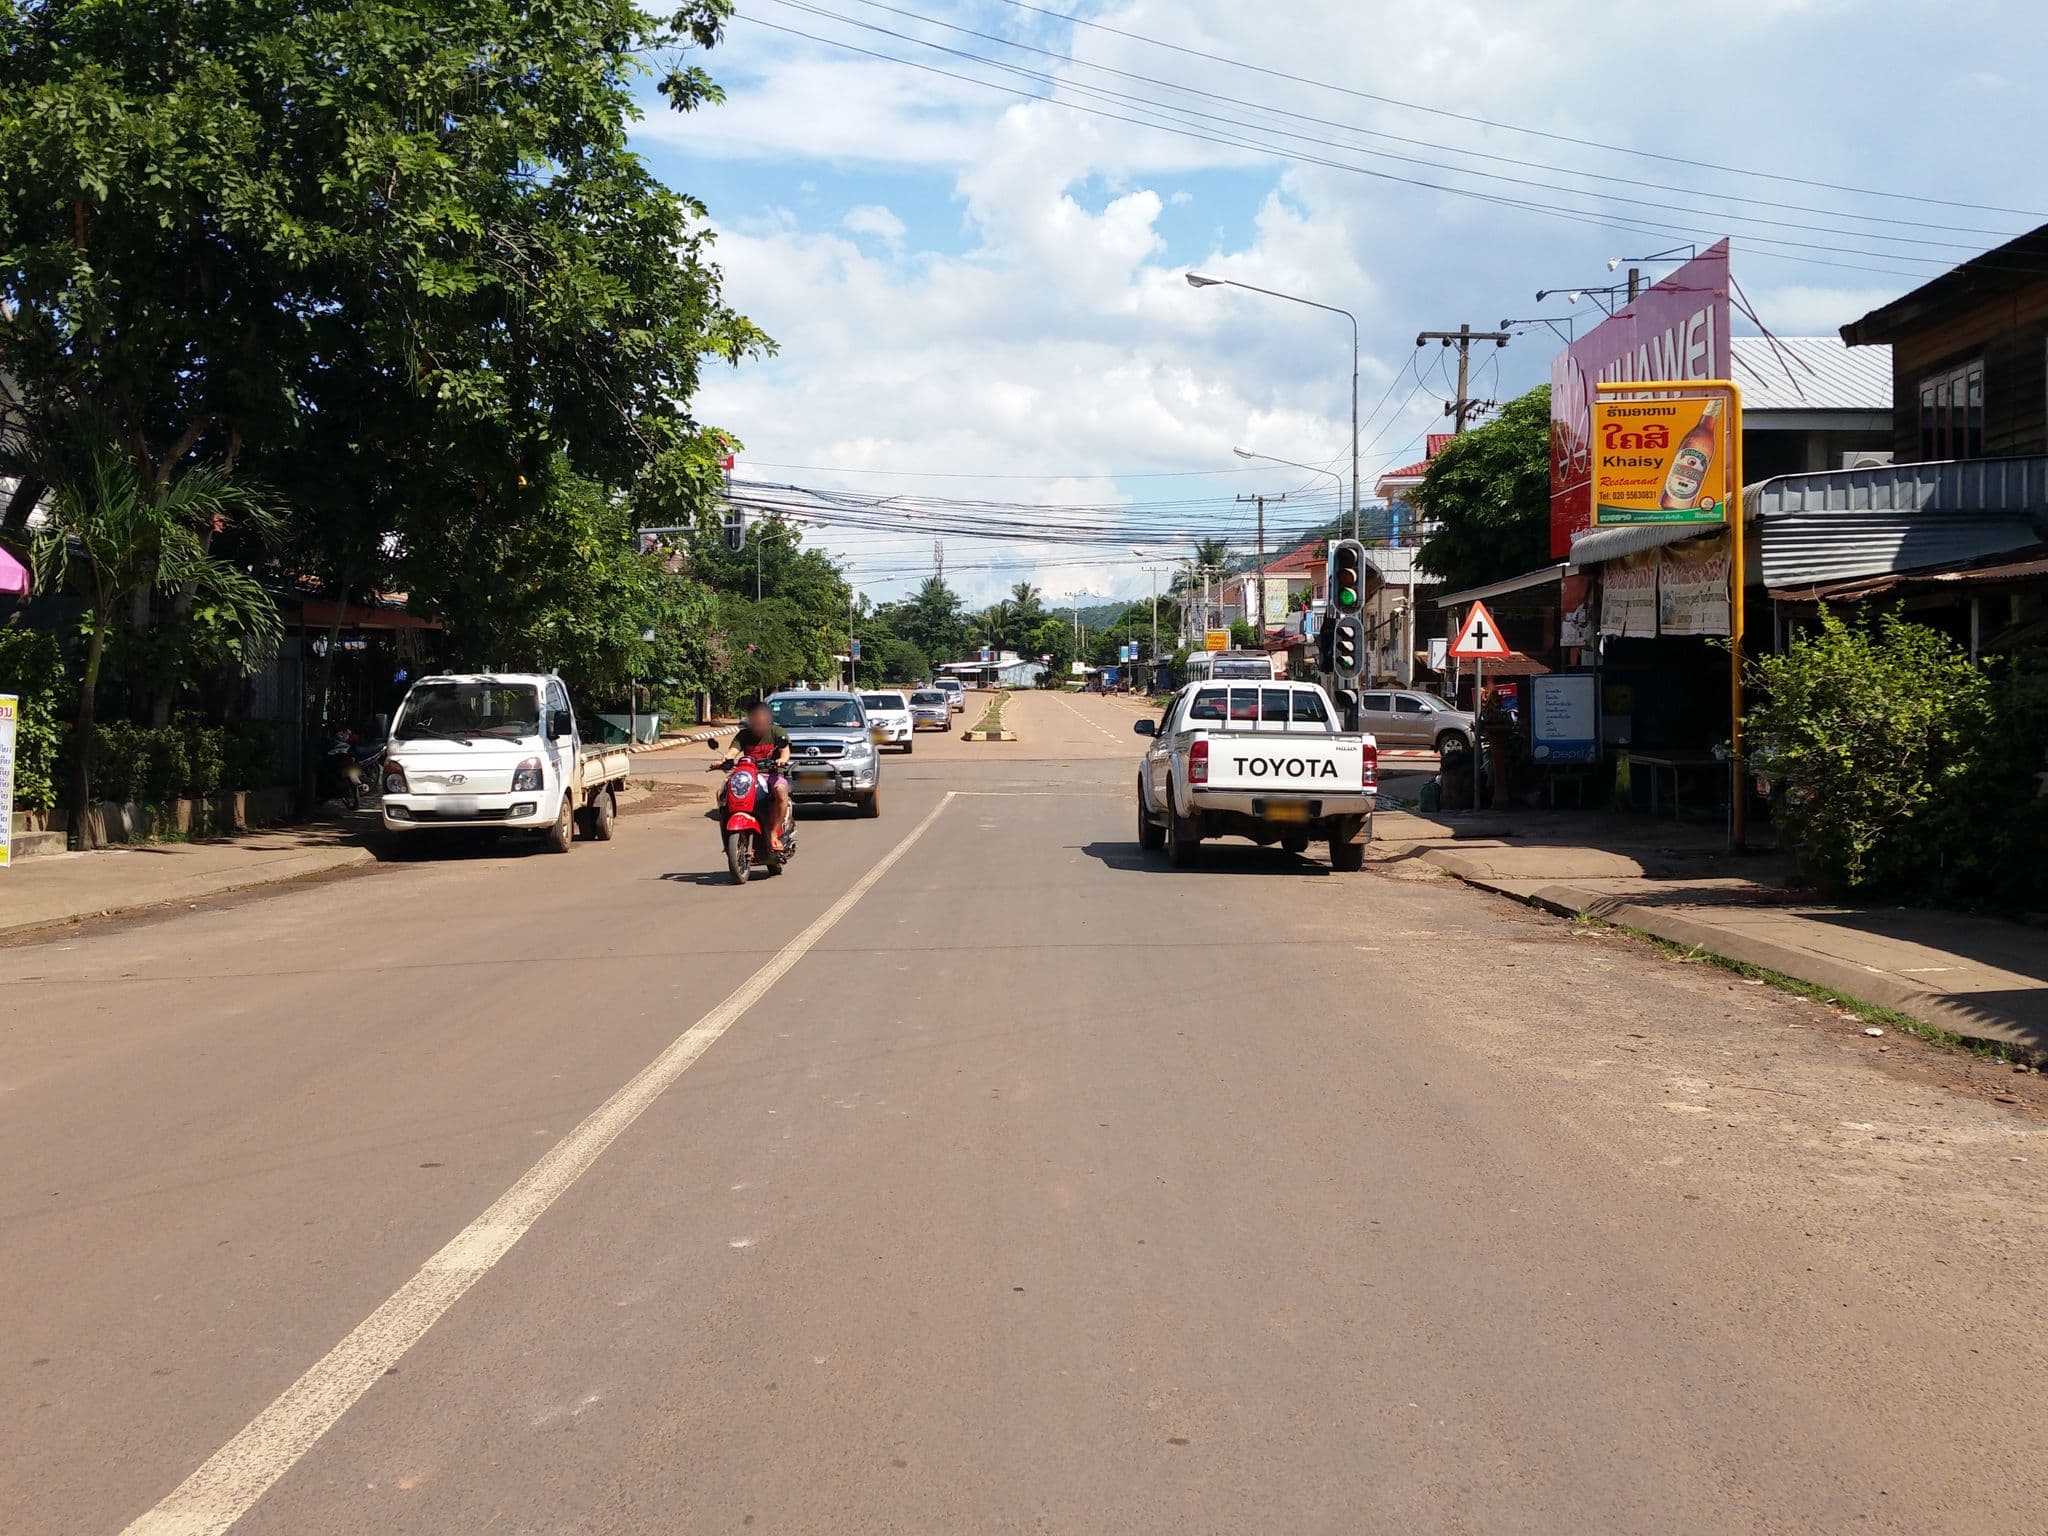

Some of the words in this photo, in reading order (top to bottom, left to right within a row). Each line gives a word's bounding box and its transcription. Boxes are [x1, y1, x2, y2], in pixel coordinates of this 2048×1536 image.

[1603, 455, 1664, 470] Khaisy
[1599, 476, 1659, 487] Restaurant
[1599, 491, 1611, 500] Tel:
[1612, 491, 1625, 500] 020
[1233, 757, 1339, 778] TOYOTA
